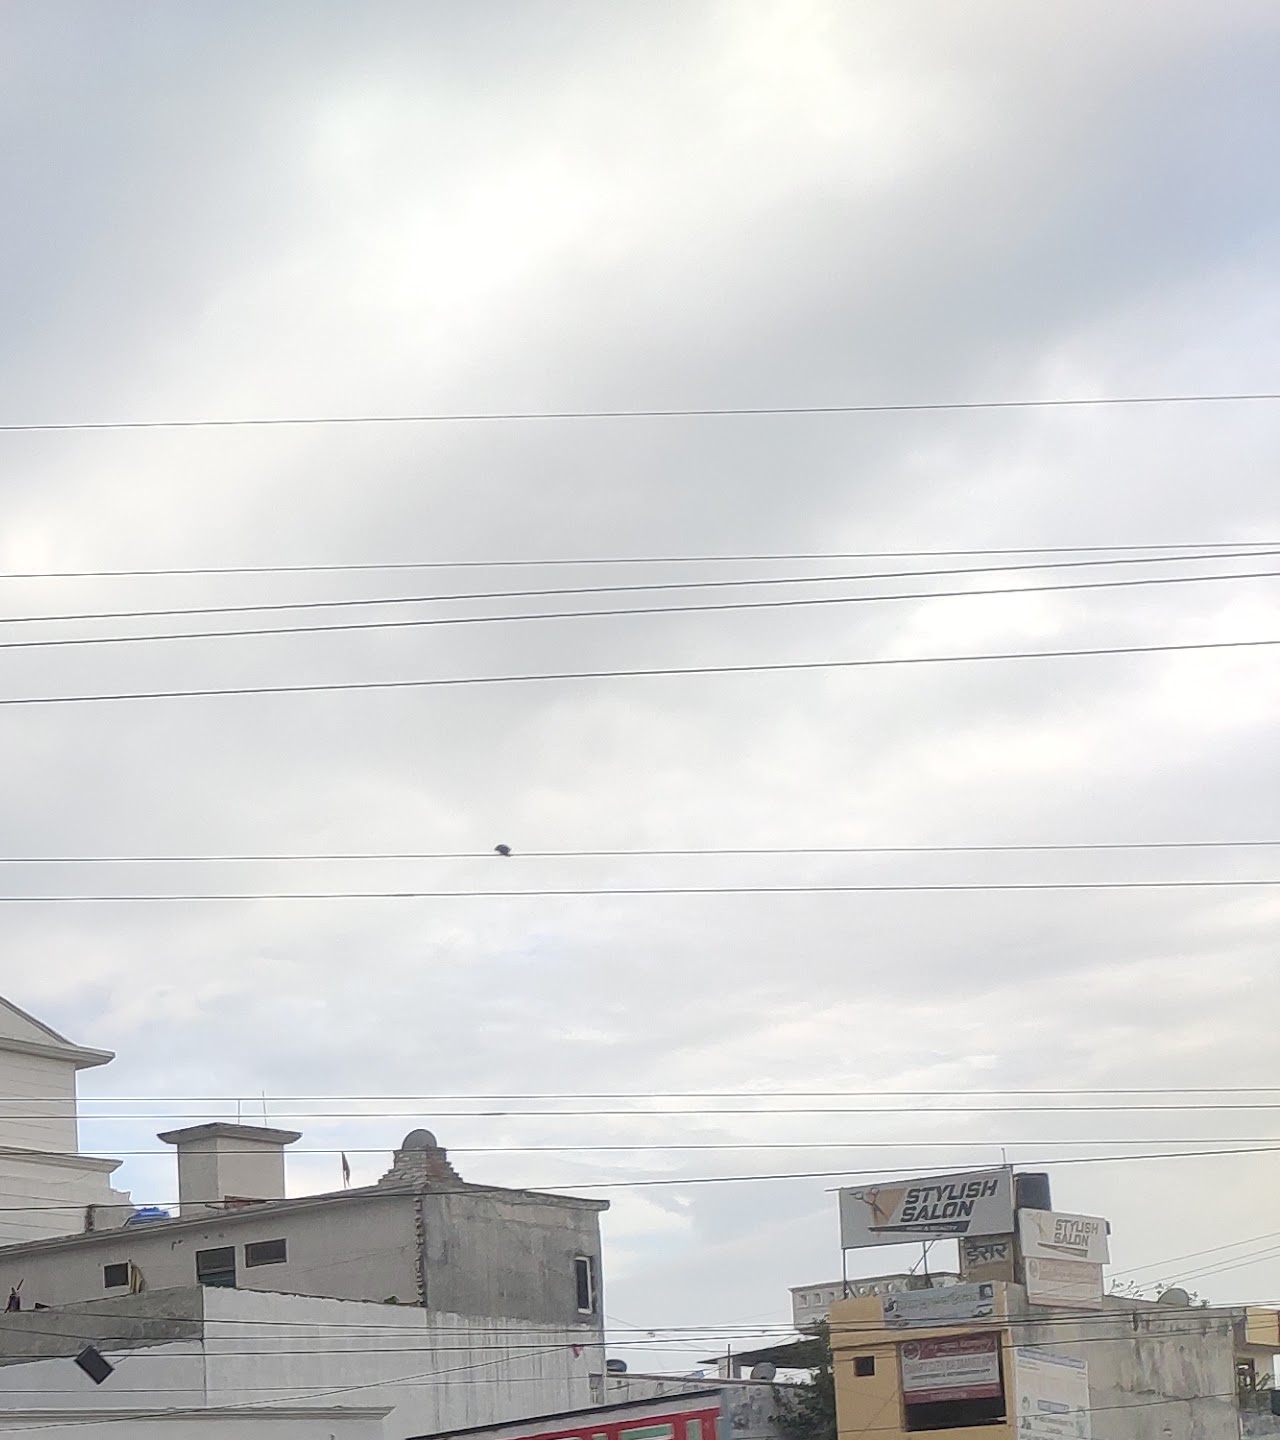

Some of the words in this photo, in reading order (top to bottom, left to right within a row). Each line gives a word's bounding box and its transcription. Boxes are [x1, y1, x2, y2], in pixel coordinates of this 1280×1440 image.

[905, 1179, 999, 1205] STYLISH
[900, 1199, 976, 1223] SALON
[1055, 1218, 1099, 1235] STYLISH
[1053, 1232, 1090, 1247] SALON
